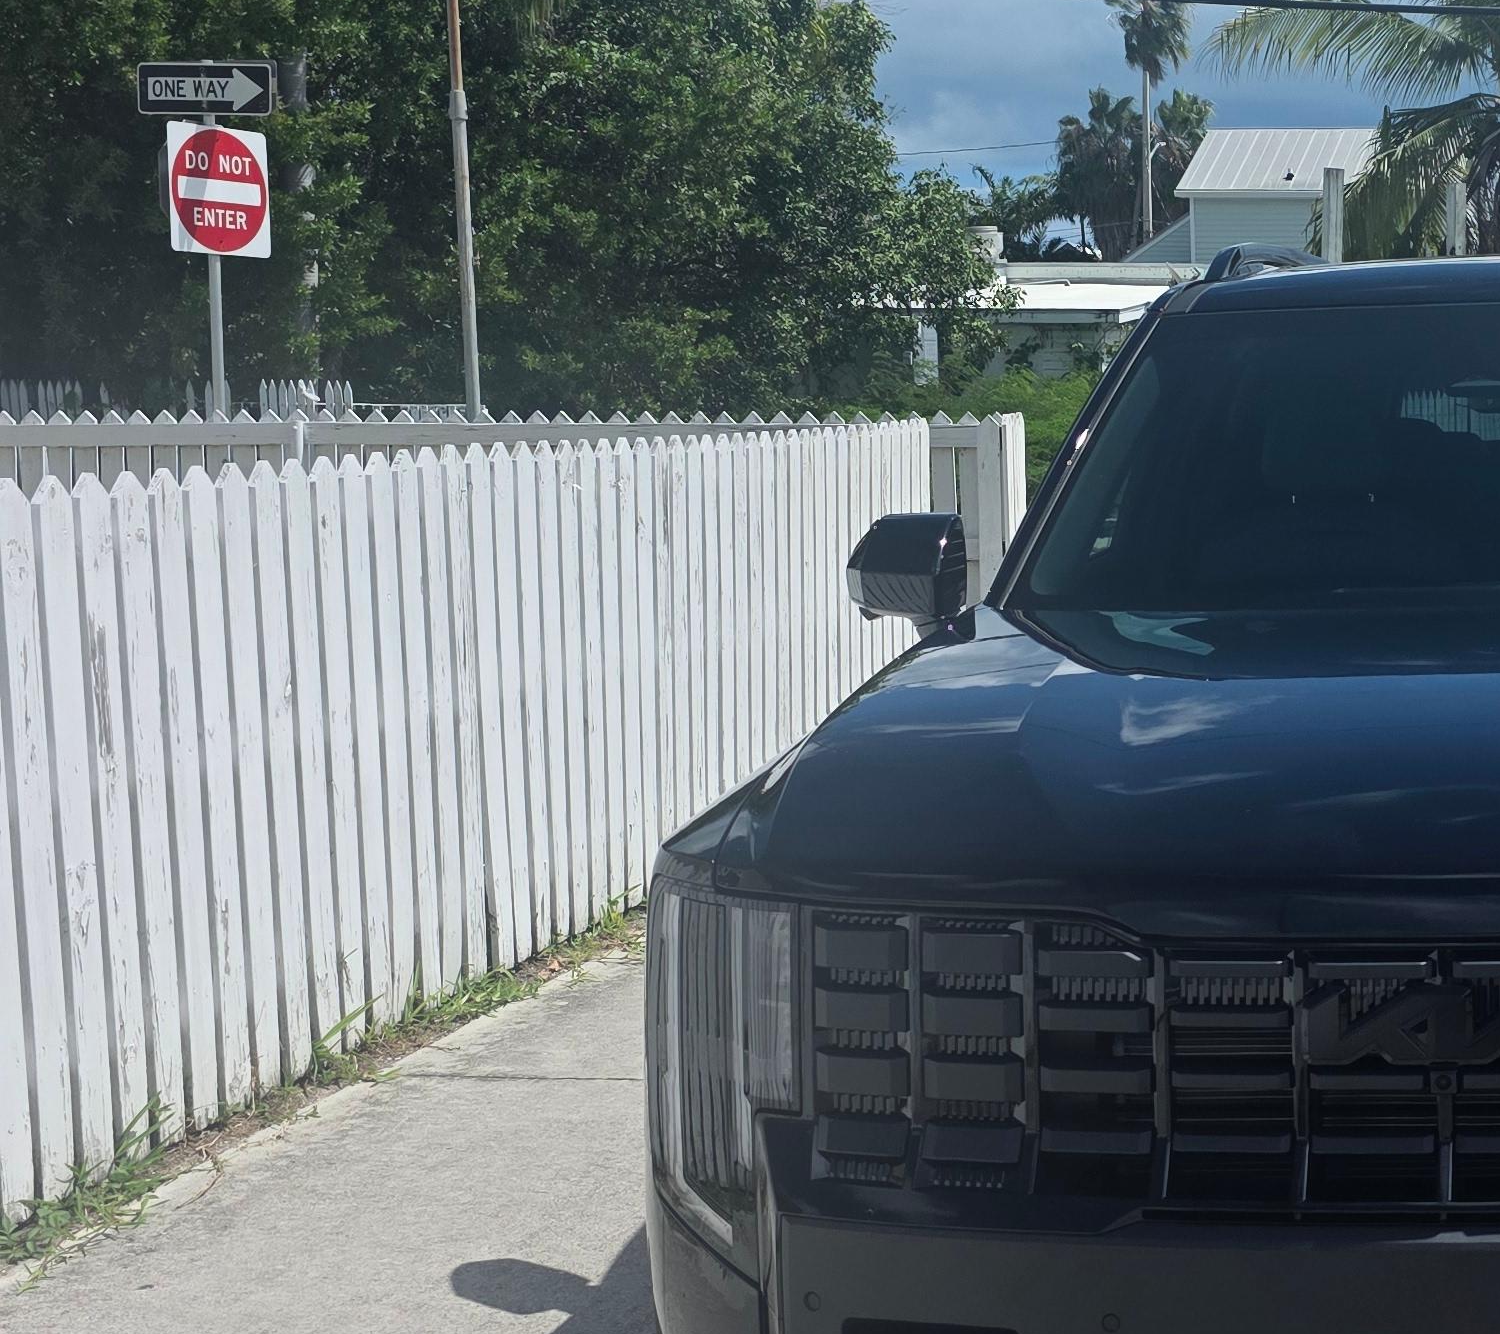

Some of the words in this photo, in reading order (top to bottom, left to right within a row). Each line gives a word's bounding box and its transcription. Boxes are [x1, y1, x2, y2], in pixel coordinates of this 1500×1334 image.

[152, 79, 186, 98] ONE
[192, 79, 230, 99] WAY
[185, 149, 209, 171] DO
[219, 154, 252, 176] NOT
[193, 207, 247, 230] ENTER
